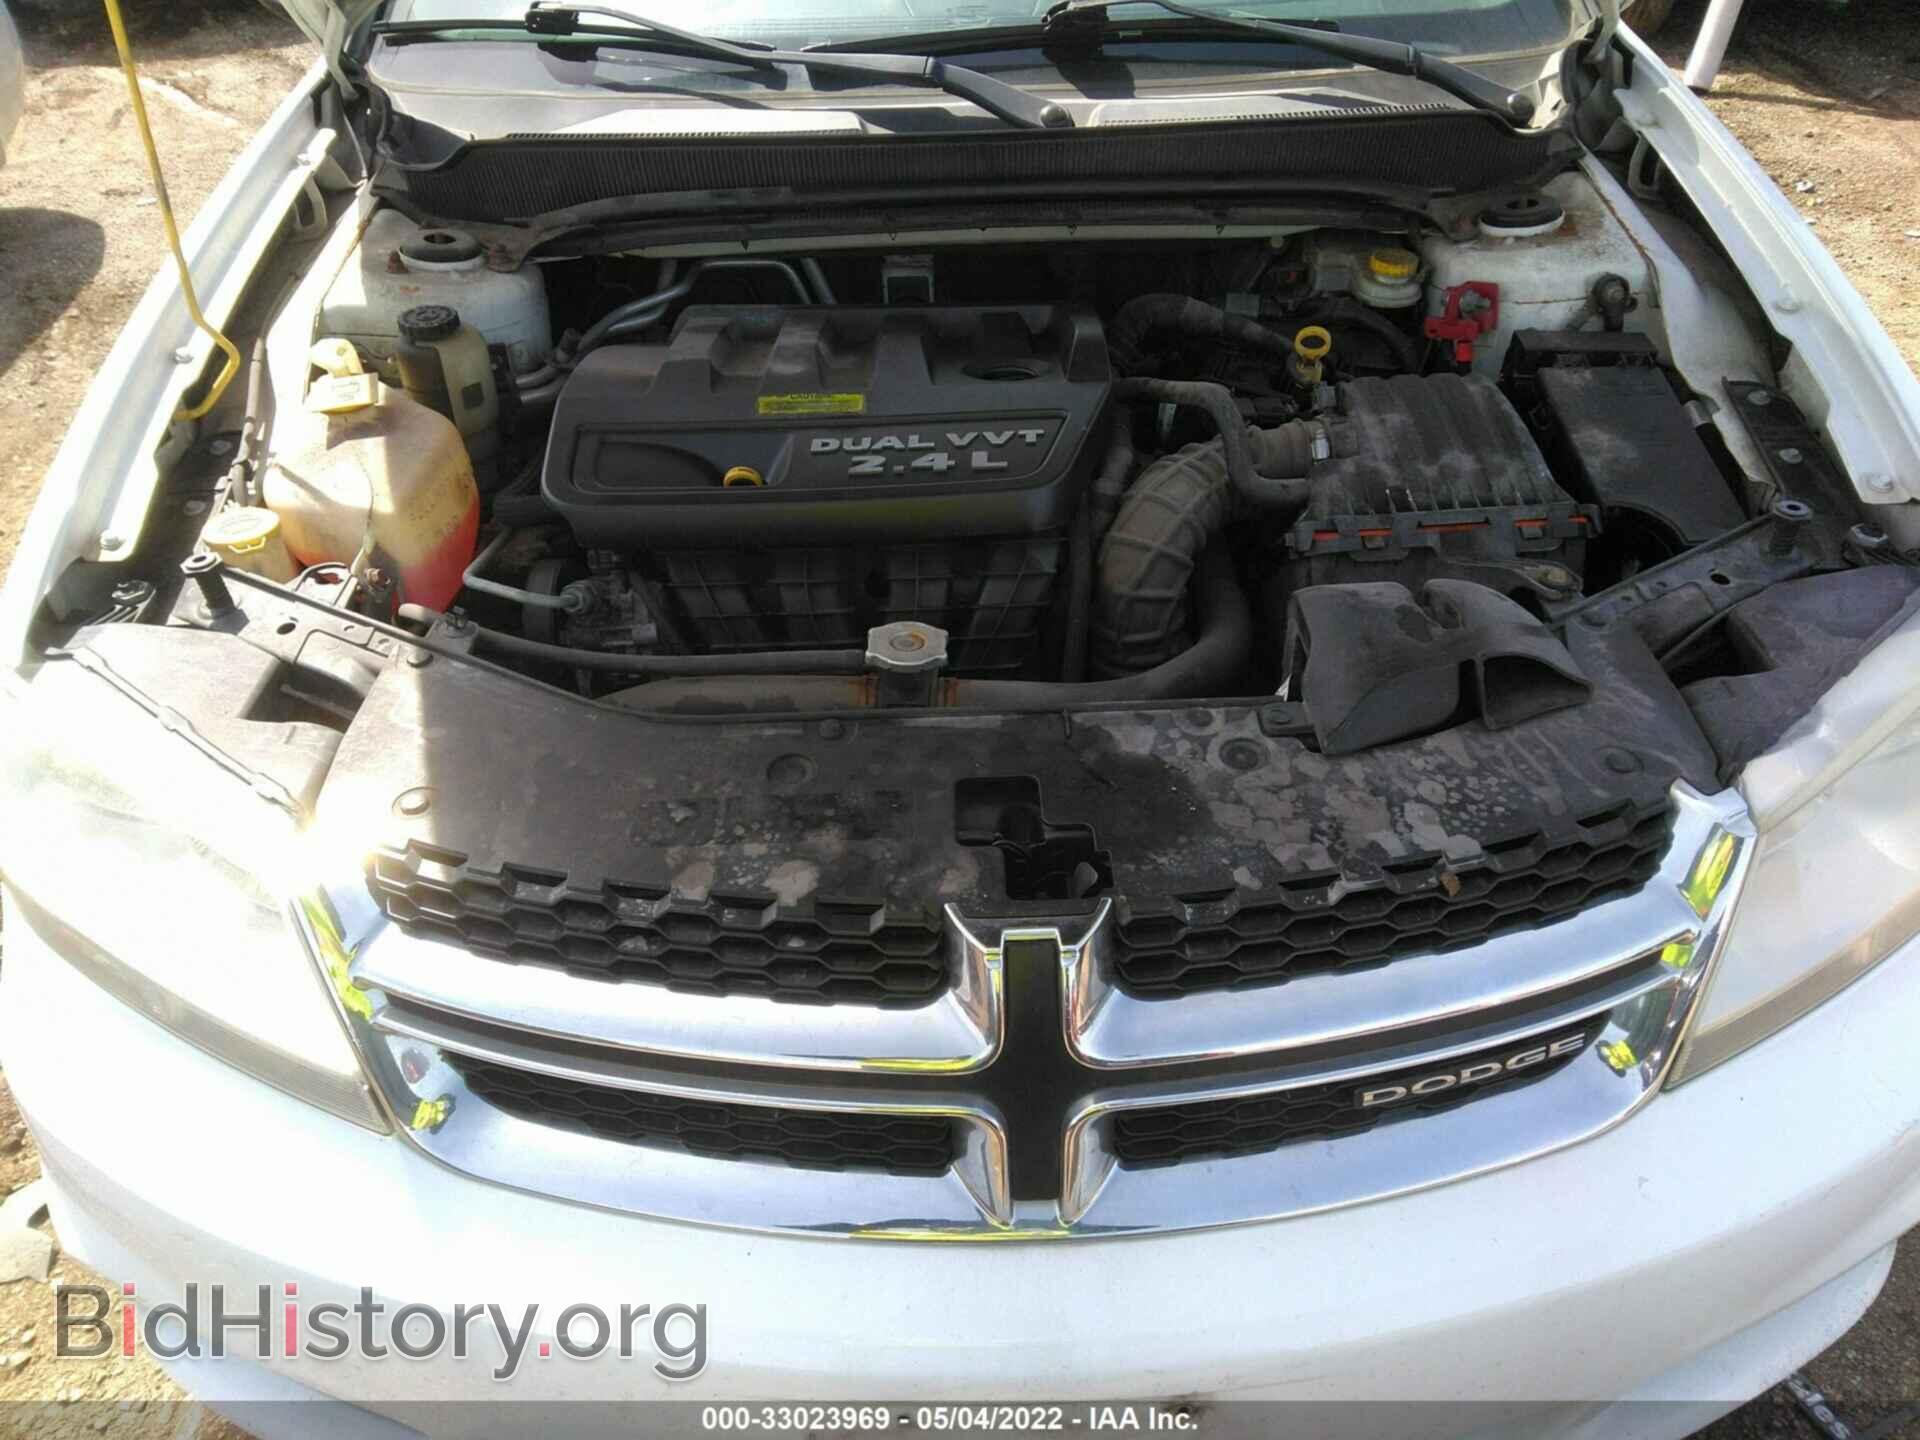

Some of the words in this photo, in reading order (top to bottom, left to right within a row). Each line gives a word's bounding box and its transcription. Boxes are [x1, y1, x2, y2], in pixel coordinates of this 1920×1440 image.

[810, 435, 935, 453] DUAL
[946, 429, 1045, 446] VVT
[1362, 1033, 1585, 1106] DODGE
